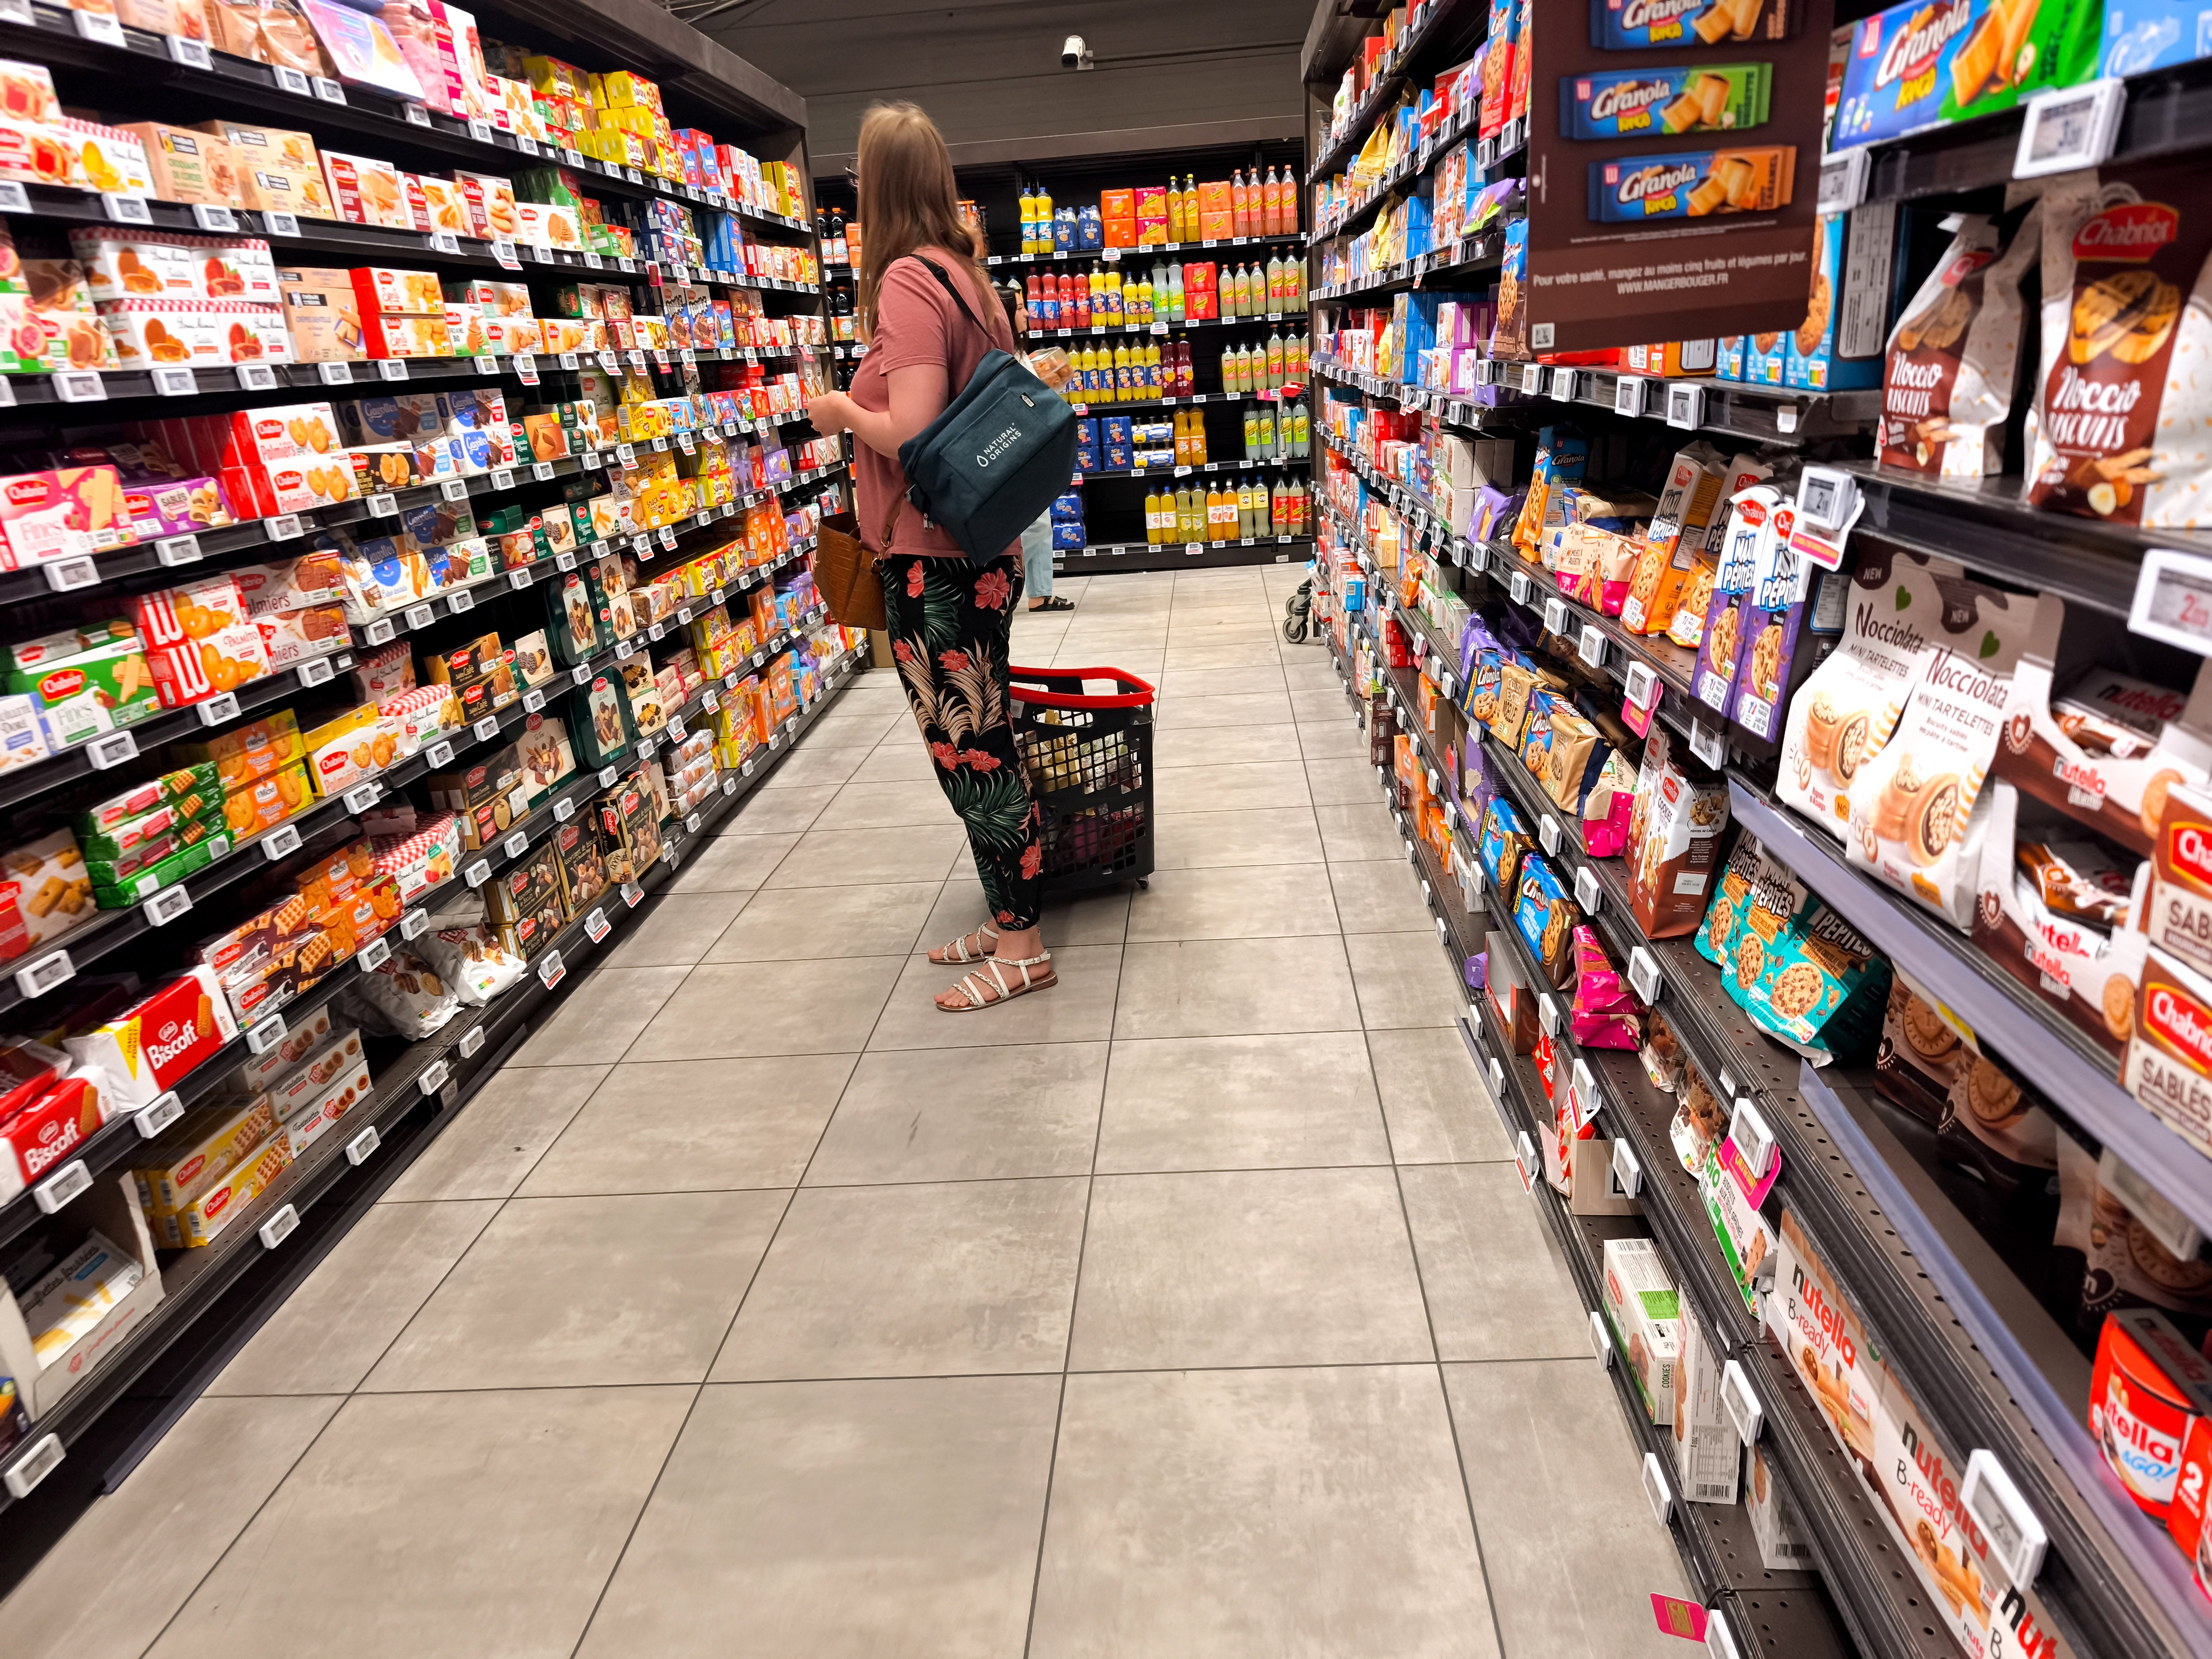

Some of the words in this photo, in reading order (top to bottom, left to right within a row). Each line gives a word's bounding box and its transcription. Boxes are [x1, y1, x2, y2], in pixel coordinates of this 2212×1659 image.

[1874, 0, 1970, 91] Granola
[1592, 80, 1669, 119] Granola
[626, 141, 643, 158] Savane
[1619, 163, 1695, 202] Granola
[1533, 274, 1552, 287] Pour
[1555, 273, 1578, 285] votre
[1580, 269, 1606, 283] santé,
[1609, 267, 1643, 280] mangez
[1644, 266, 1655, 277] au
[1657, 263, 1682, 275] moins
[1685, 261, 1702, 273] cinq
[1705, 258, 1726, 270] fruits
[1728, 257, 1736, 268] et
[1738, 254, 1772, 269] légumes
[1774, 252, 1788, 266] par
[1790, 251, 1808, 264] jour.
[1617, 273, 1729, 295] WWW.MANGERBOUGER.FR
[1891, 352, 1943, 388] Noccio
[2052, 365, 2141, 414] Noccio
[365, 401, 398, 419] Gavottes
[1887, 388, 1932, 416] BISCUITS
[983, 425, 1017, 455] NATURAL
[2049, 413, 2129, 449] BISCUITS
[261, 442, 296, 460] Palmiers
[467, 434, 489, 452] Gavottes
[989, 430, 1022, 461] ORIGINS
[1551, 454, 1586, 466] Granola
[276, 475, 302, 487] Chabrior
[161, 492, 187, 506] SABLÉS
[279, 493, 316, 513] Palmiers
[1241, 495, 1251, 504] KAS
[1258, 494, 1268, 503] KAS
[407, 510, 436, 527] Gavottes
[1740, 503, 1766, 521] Chabrior
[20, 518, 62, 541] Fines
[363, 544, 396, 564] Gavottes
[1735, 535, 1755, 562] MAXI
[1723, 562, 1755, 591] PÉPITES
[1863, 568, 1882, 580] NEW
[1761, 579, 1799, 608] PÉPITES
[142, 591, 184, 645] LU
[1951, 610, 1970, 623] NEW
[223, 631, 258, 647] PALMITO
[1856, 602, 1924, 655] Nocciolata
[170, 641, 210, 700] LU
[452, 654, 470, 665] Chabrior
[1848, 643, 1867, 657] MINI
[1866, 650, 1909, 677] TARTELETTES
[43, 671, 84, 695] Chabrior
[462, 666, 475, 677] Café
[1477, 666, 1501, 686] Granola
[1926, 647, 2008, 710] Nocciolata
[466, 688, 484, 701] Chabrior
[592, 680, 607, 690] Delacre
[1507, 692, 1522, 705] EXTRA
[1523, 714, 1532, 737] FORMAT
[1917, 692, 1932, 708] MINI
[1932, 699, 1995, 737] TARTELETTES
[251, 752, 274, 767] Palmier
[321, 753, 348, 770] Chabrior
[468, 771, 485, 786] Chabrior
[2053, 756, 2106, 795] nutella
[262, 786, 276, 796] Michel
[1663, 779, 1679, 800] CHABRIOR
[261, 801, 284, 817] Palmier
[625, 797, 639, 811] Chabrior
[1658, 796, 1672, 822] COOKIES
[606, 811, 615, 834] Chabrior
[561, 830, 580, 845] Chabrior
[585, 835, 599, 850] biscuits
[612, 854, 622, 870] MAXI
[1729, 847, 1761, 883] PÉPITES
[514, 876, 528, 890] Chabrior
[1753, 879, 1793, 919] PÉPITES
[521, 922, 536, 937] Chabrior
[1815, 910, 1873, 954] PÉPITES
[213, 946, 242, 964] Chabrior
[2025, 941, 2070, 987] nutella
[241, 985, 267, 1004] Chabrior
[146, 1019, 199, 1070] Biscoff
[276, 1074, 305, 1095] Tartelettes
[2142, 1057, 2212, 1123] SABLÉS
[293, 1110, 320, 1132] Tartelettes
[24, 1117, 81, 1175] Biscoff
[178, 1156, 204, 1181] Chabrior
[207, 1188, 230, 1214] Chabrior
[1722, 1176, 1736, 1206] BISCUITS
[1731, 1213, 1743, 1239] GRAINES
[1793, 1263, 1857, 1370] nutella
[1788, 1298, 1830, 1359] B-ready
[1662, 1363, 1671, 1389] COOKIES
[1902, 1420, 1989, 1562] nutella
[2182, 1462, 2203, 1502] 2
[1897, 1458, 1953, 1540] B-ready
